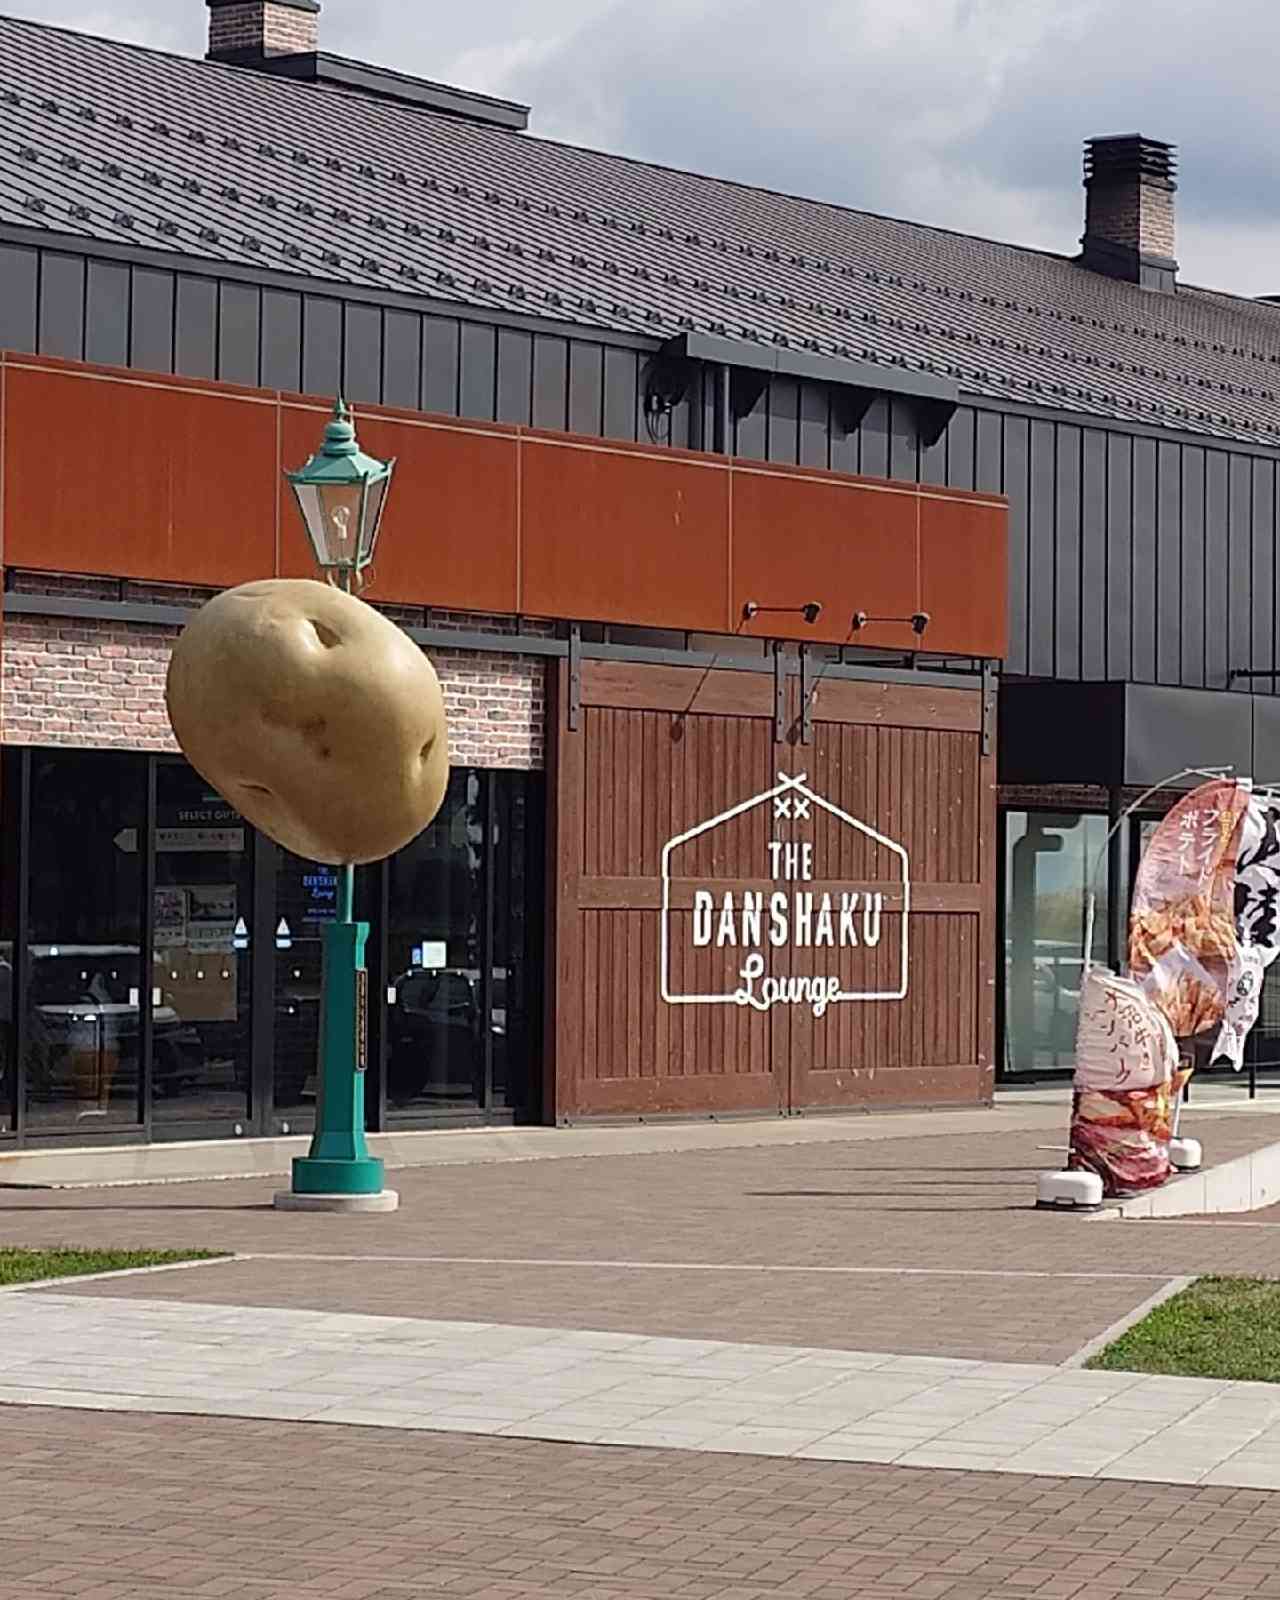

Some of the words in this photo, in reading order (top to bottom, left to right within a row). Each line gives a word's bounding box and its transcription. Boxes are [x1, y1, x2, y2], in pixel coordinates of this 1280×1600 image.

[767, 842, 813, 881] THE
[1178, 809, 1200, 876] ポテト
[1196, 808, 1220, 887] フライド
[692, 890, 883, 947] DANSHAKU
[735, 952, 841, 1017] Lounge
